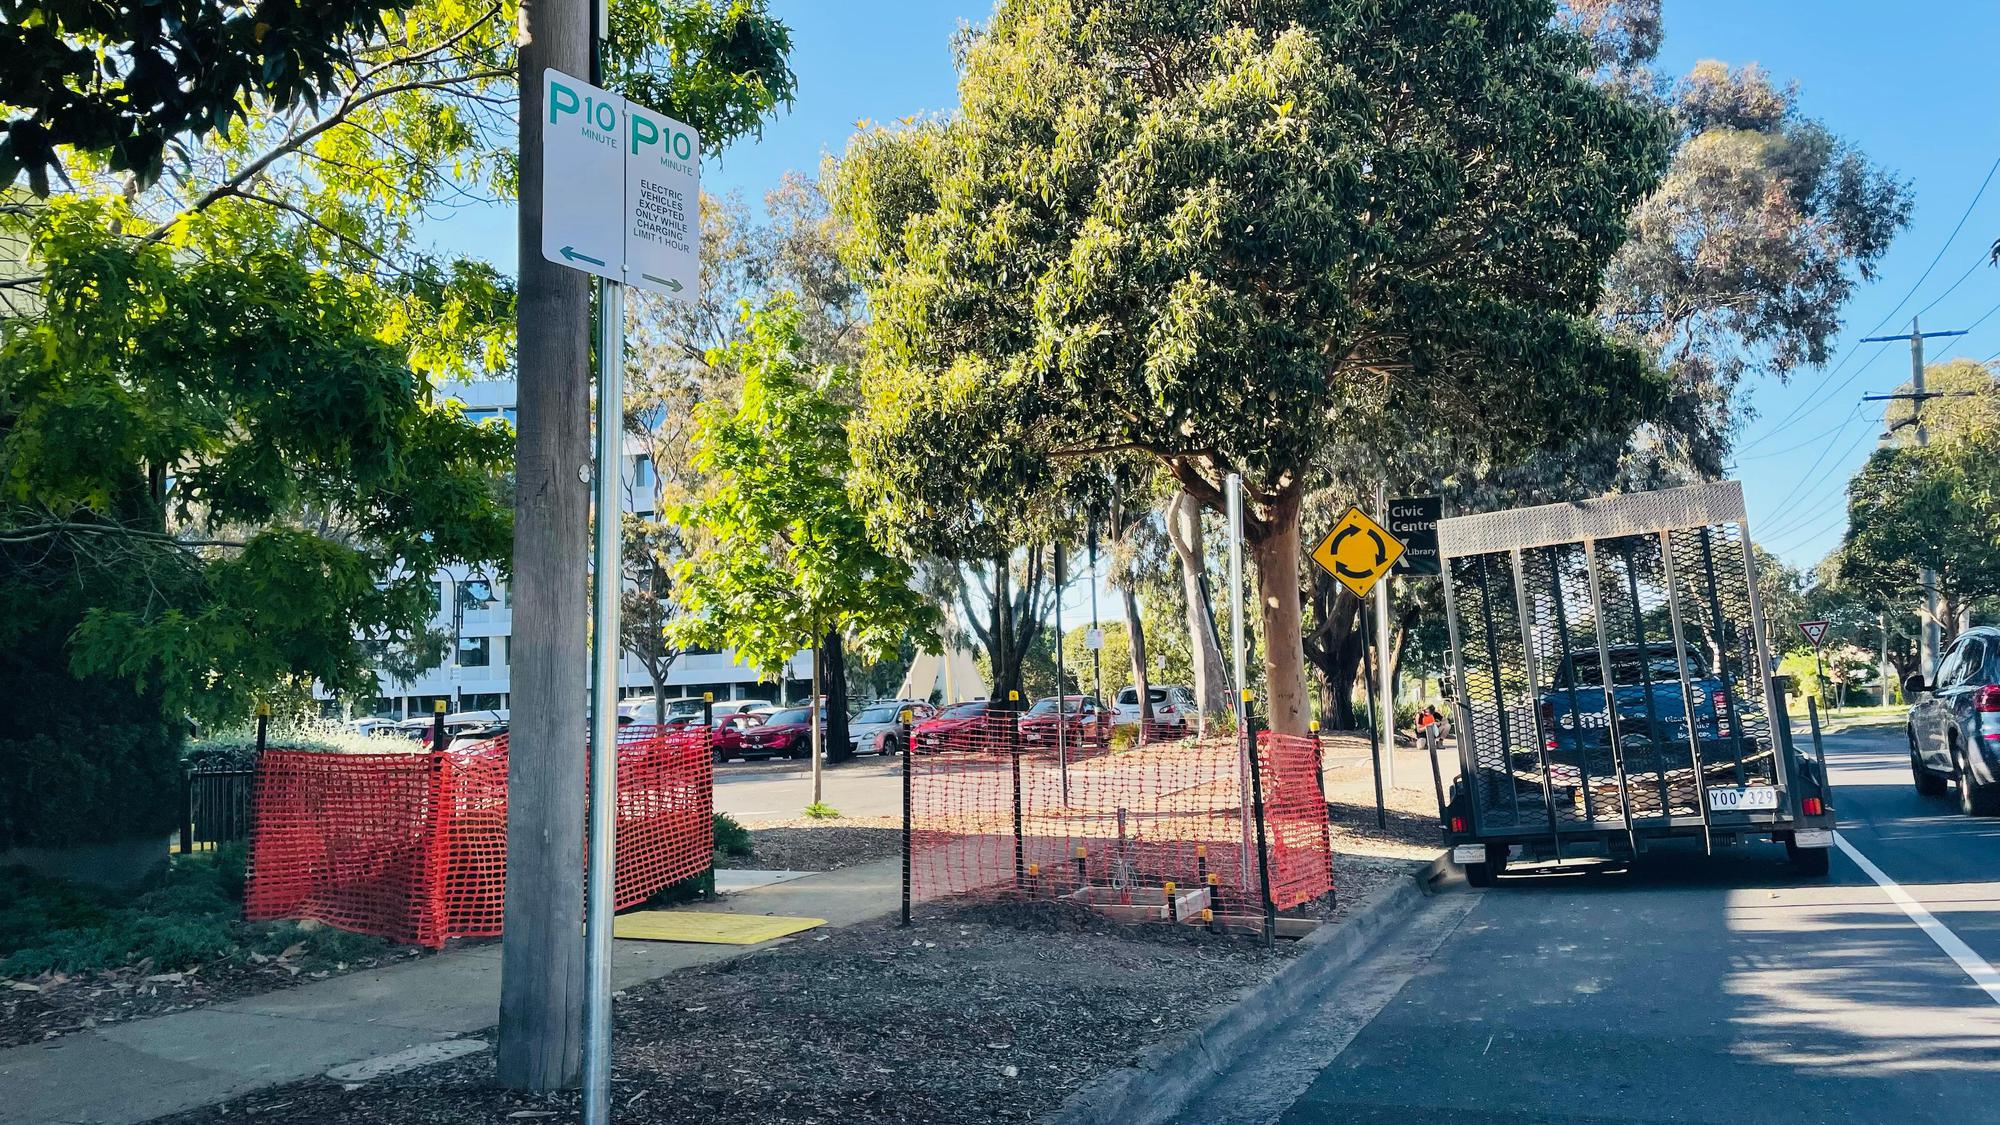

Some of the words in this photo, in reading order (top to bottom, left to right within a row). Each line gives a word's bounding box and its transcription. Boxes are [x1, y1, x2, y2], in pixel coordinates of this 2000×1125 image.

[581, 127, 617, 149] MINUTE
[660, 157, 693, 176] MINUTE
[640, 179, 683, 201] ELECTRIC
[640, 189, 683, 211] VEHICLES
[635, 208, 659, 222] ONLY
[660, 215, 688, 233] WHILE
[639, 199, 684, 221] EXCEPTED
[633, 228, 655, 243] LIMIT
[658, 236, 662, 244] 1
[665, 239, 690, 254] HOUR
[636, 219, 683, 241] CHARGING
[1392, 505, 1424, 517] Civic
[1392, 521, 1437, 532] Centre
[1407, 548, 1436, 556] Library
[1748, 791, 1773, 804] 329
